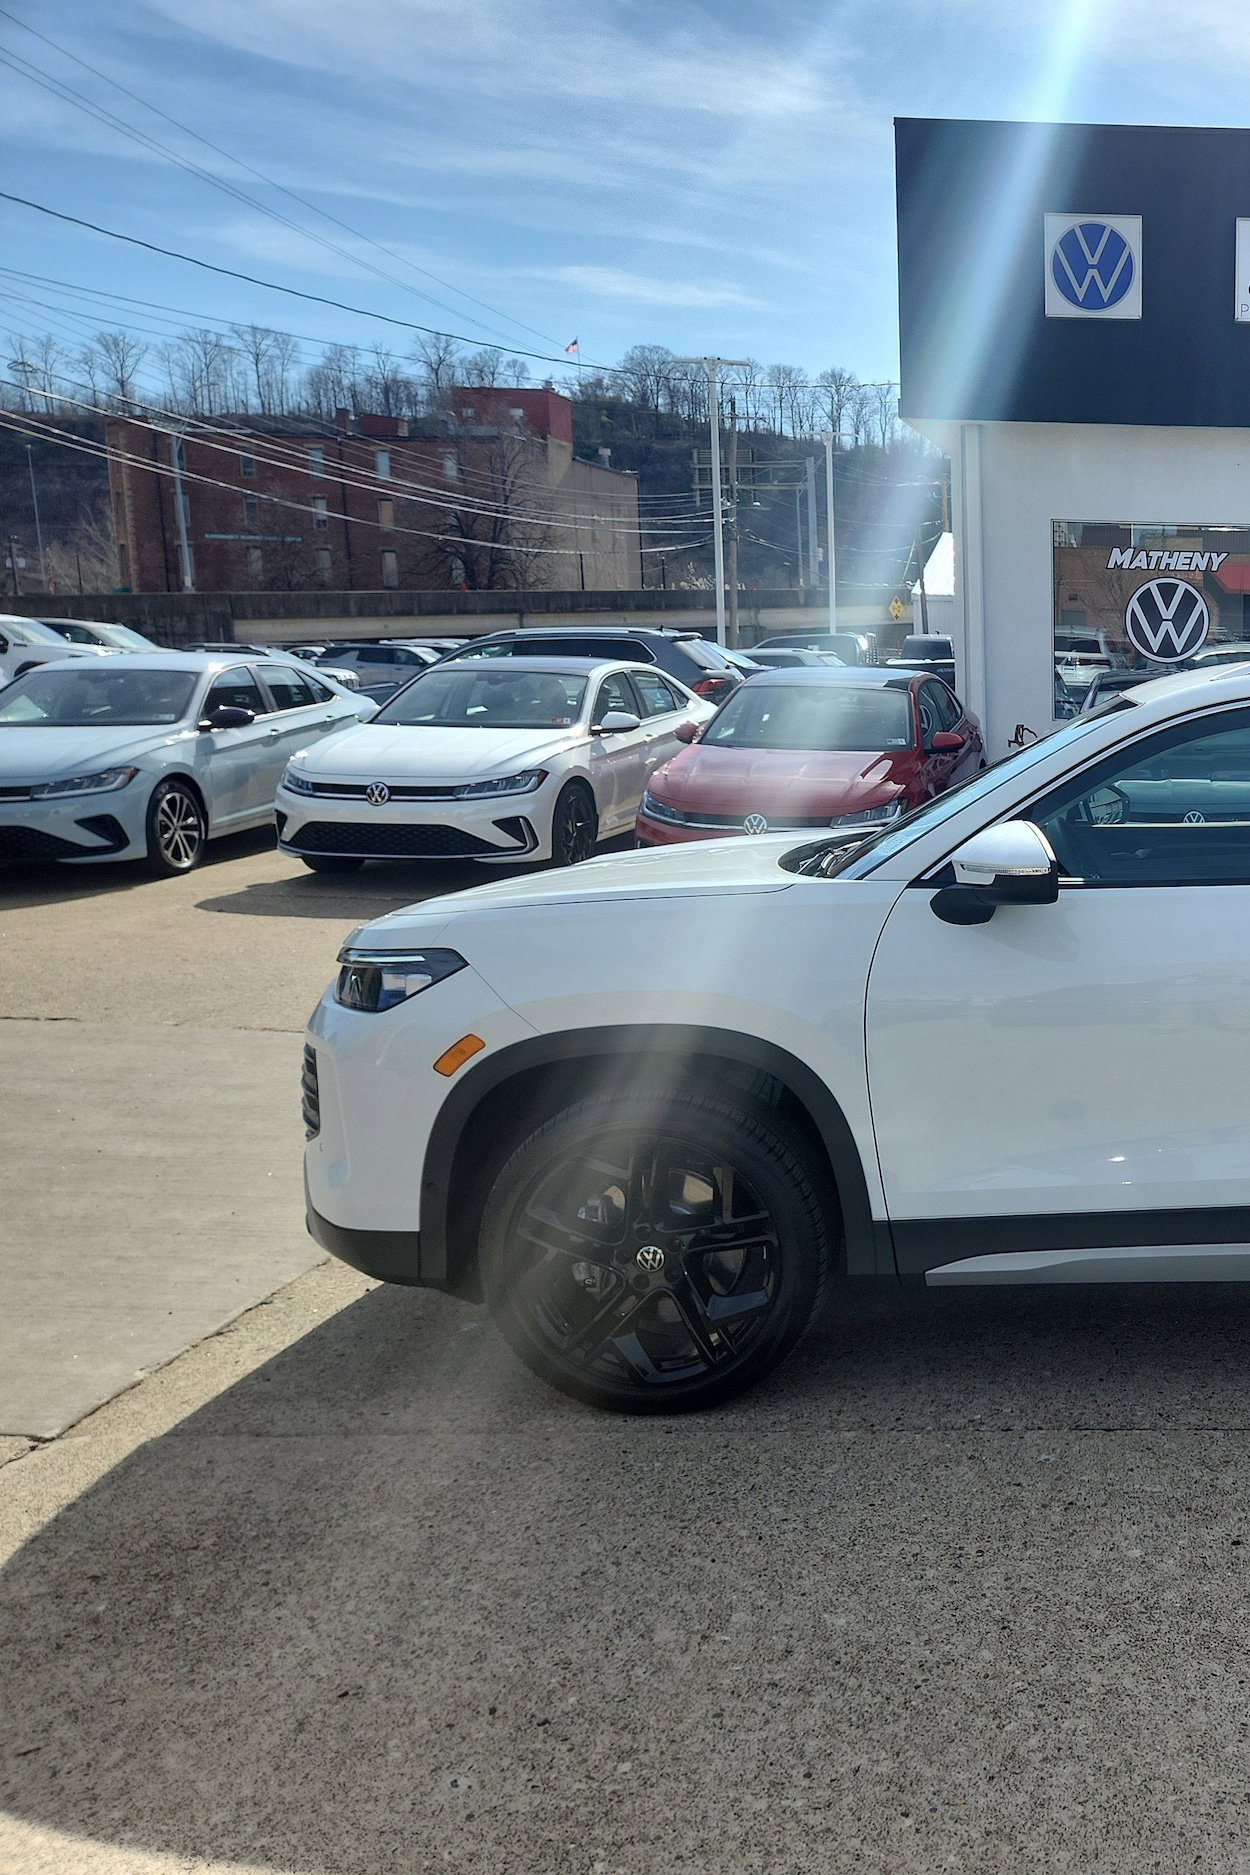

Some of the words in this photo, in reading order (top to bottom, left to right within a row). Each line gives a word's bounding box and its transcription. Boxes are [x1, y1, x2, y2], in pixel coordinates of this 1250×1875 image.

[1053, 222, 1134, 310] VW
[1106, 547, 1229, 572] MATHENY
[1126, 578, 1210, 663] VW
